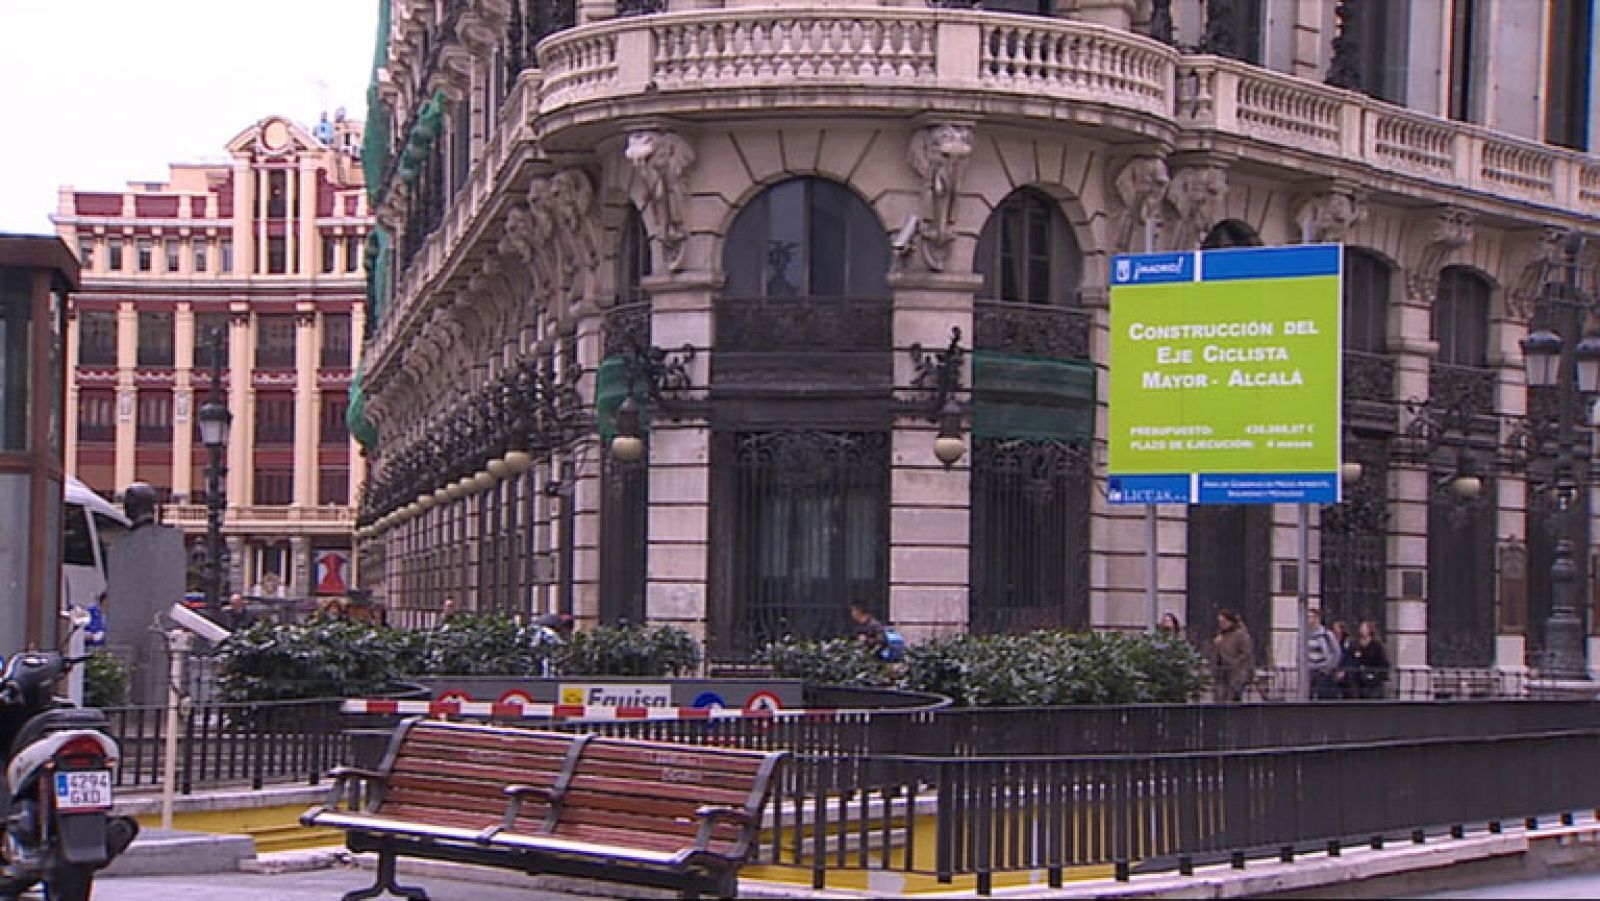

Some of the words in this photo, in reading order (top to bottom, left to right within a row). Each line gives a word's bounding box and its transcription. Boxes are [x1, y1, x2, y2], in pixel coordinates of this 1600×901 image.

[1283, 320, 1319, 335] DEL
[1157, 346, 1192, 364] EJE
[1203, 345, 1289, 363] CICLISTA
[1228, 367, 1303, 387] ALCALÁ
